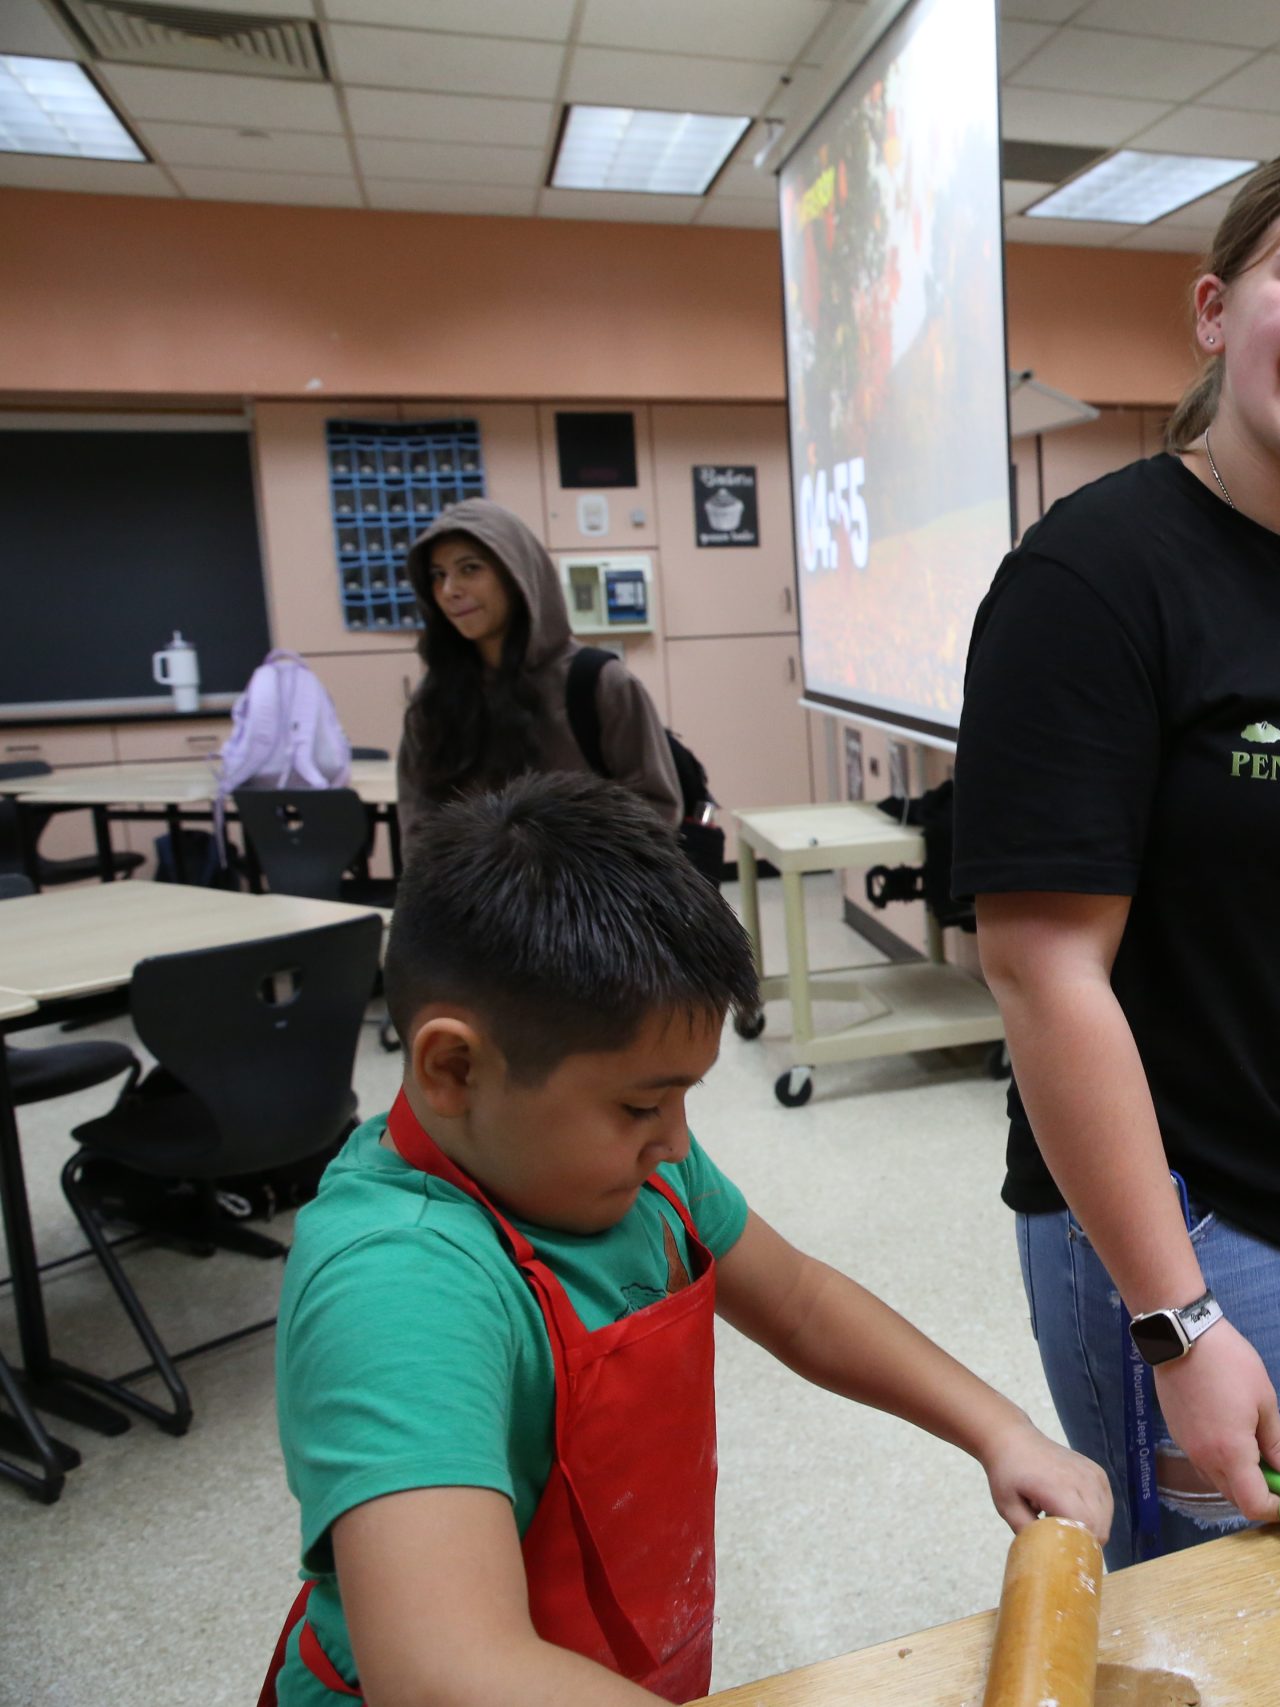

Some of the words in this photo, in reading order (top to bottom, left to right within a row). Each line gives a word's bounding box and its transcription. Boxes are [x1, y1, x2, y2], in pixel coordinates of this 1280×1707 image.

[800, 457, 869, 572] 04:55
[1133, 1364, 1147, 1417] Mountain
[1136, 1421, 1148, 1445] Jeep
[1139, 1448, 1151, 1500] Outfitters
